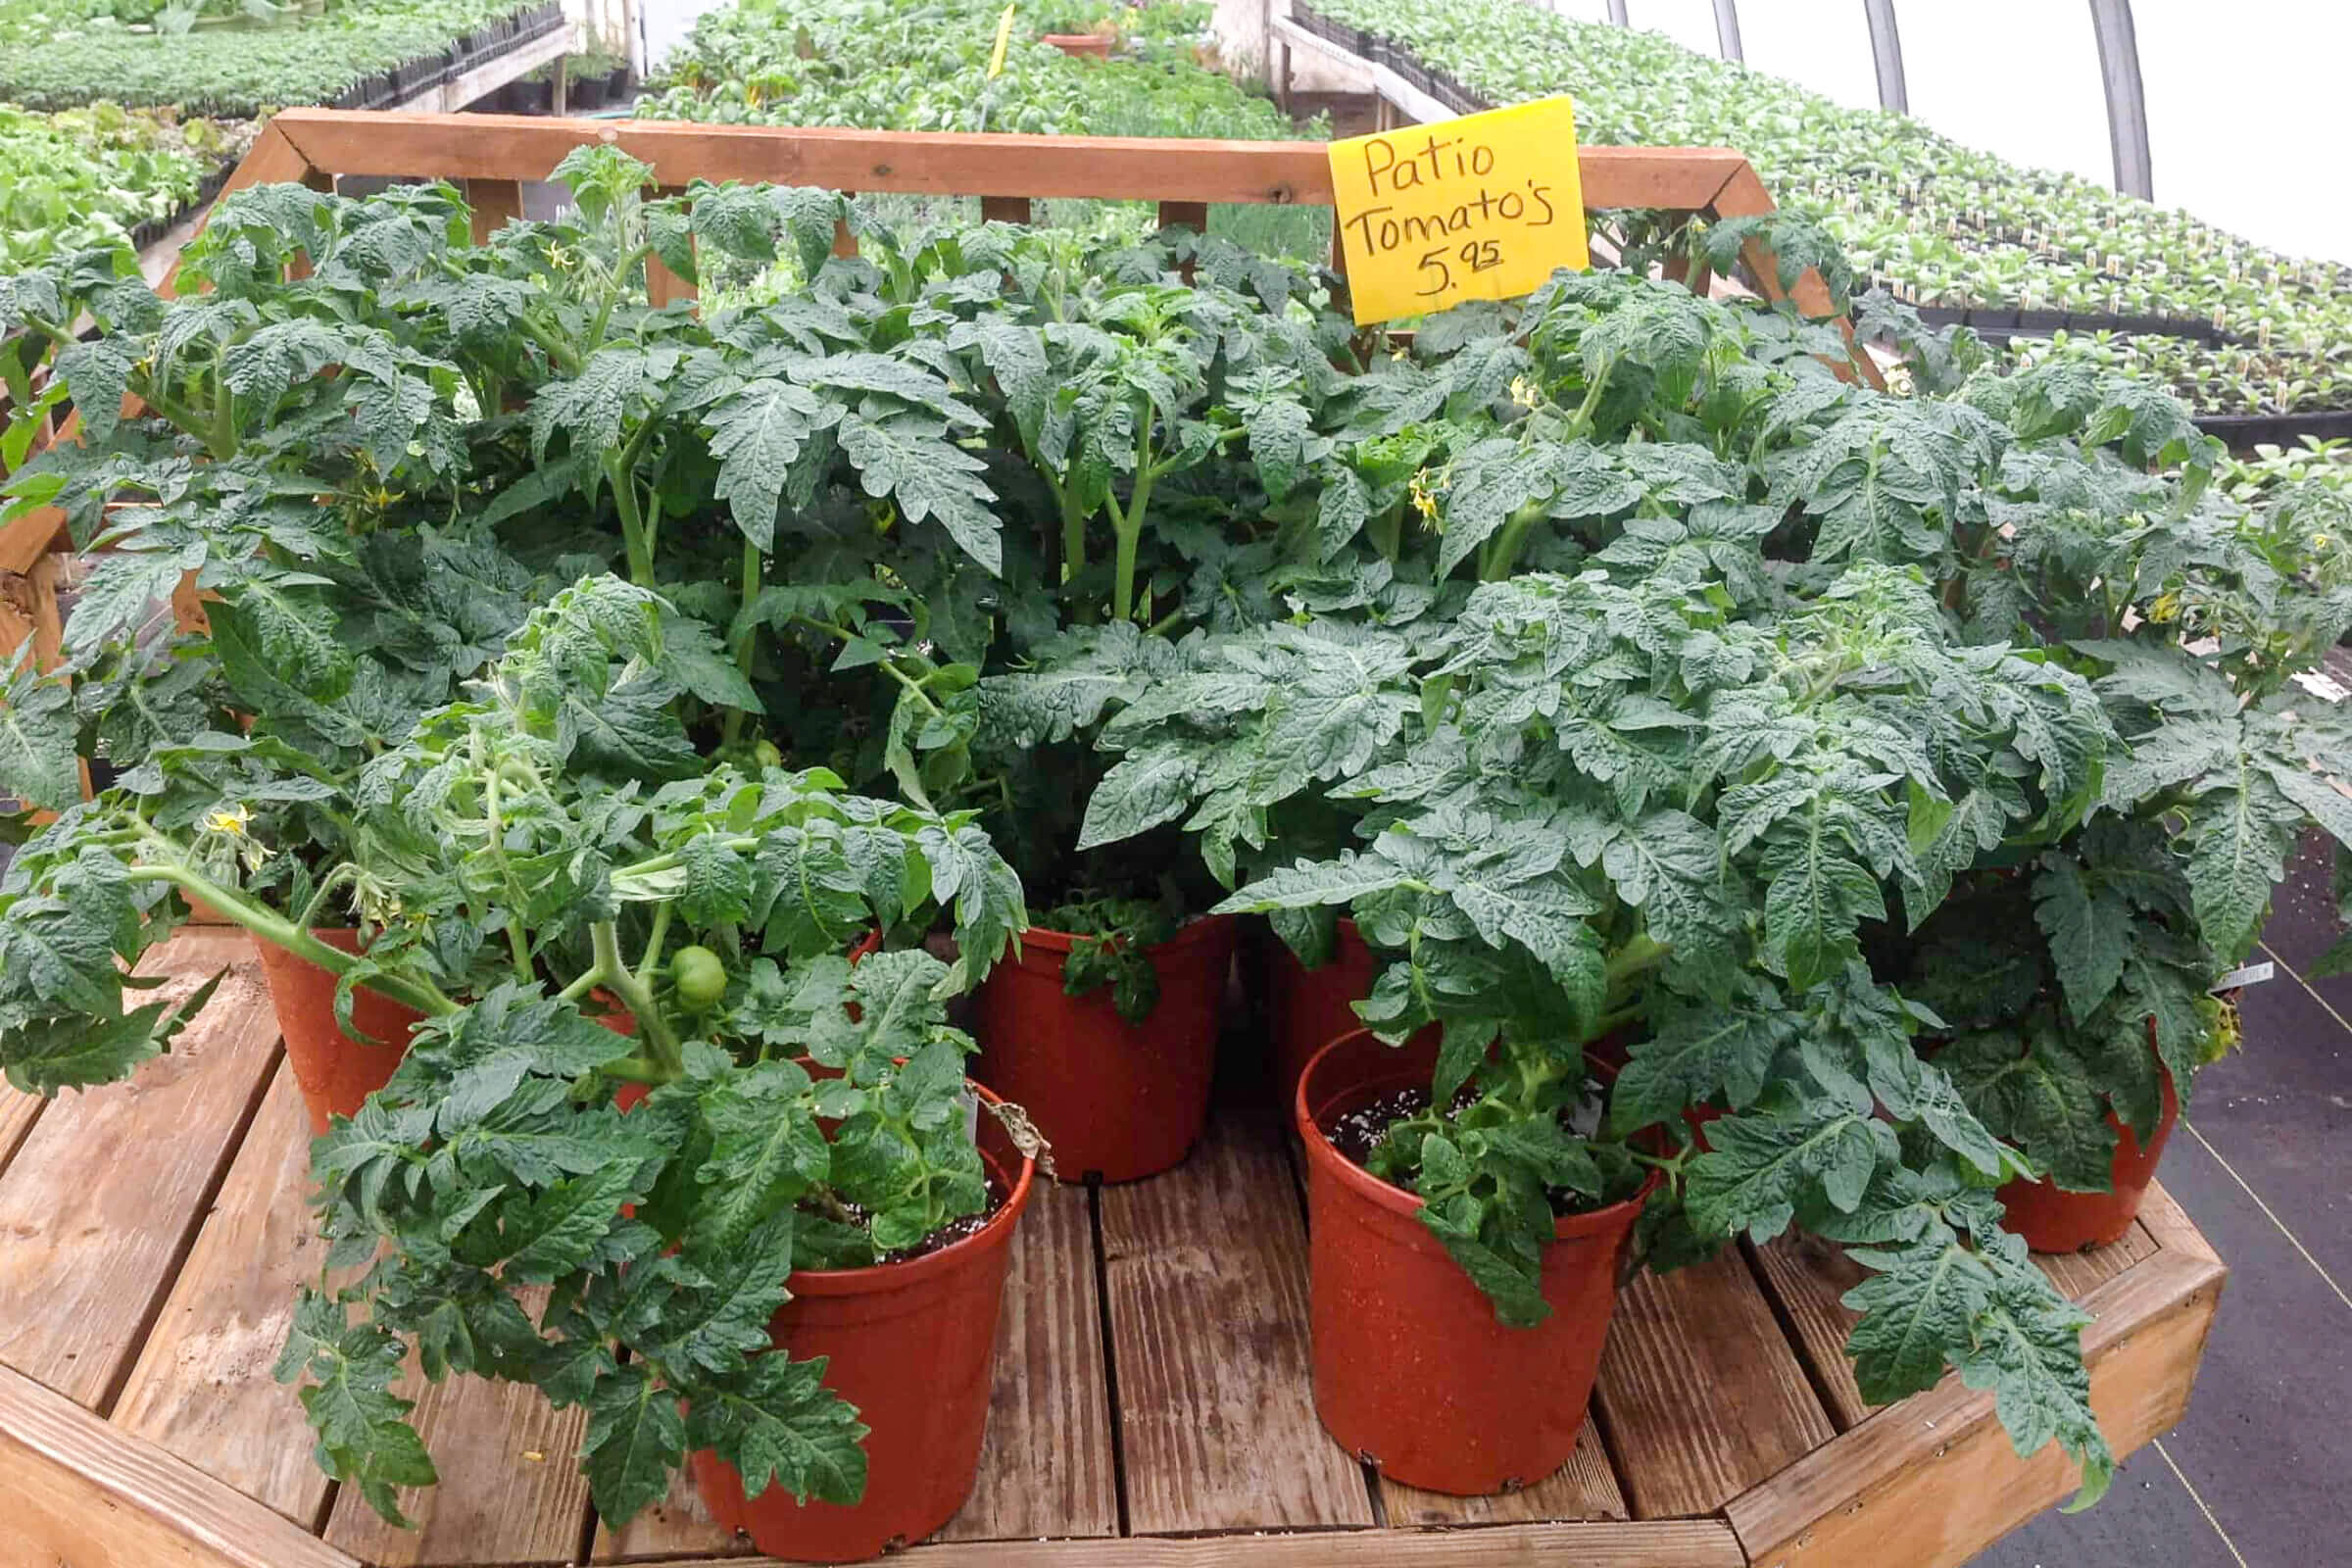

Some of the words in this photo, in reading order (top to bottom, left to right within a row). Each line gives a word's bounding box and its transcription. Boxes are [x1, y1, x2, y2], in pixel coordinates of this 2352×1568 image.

[1364, 135, 1494, 196] Patio
[1345, 179, 1553, 257] Tomato's
[1415, 240, 1504, 296] 5.95
